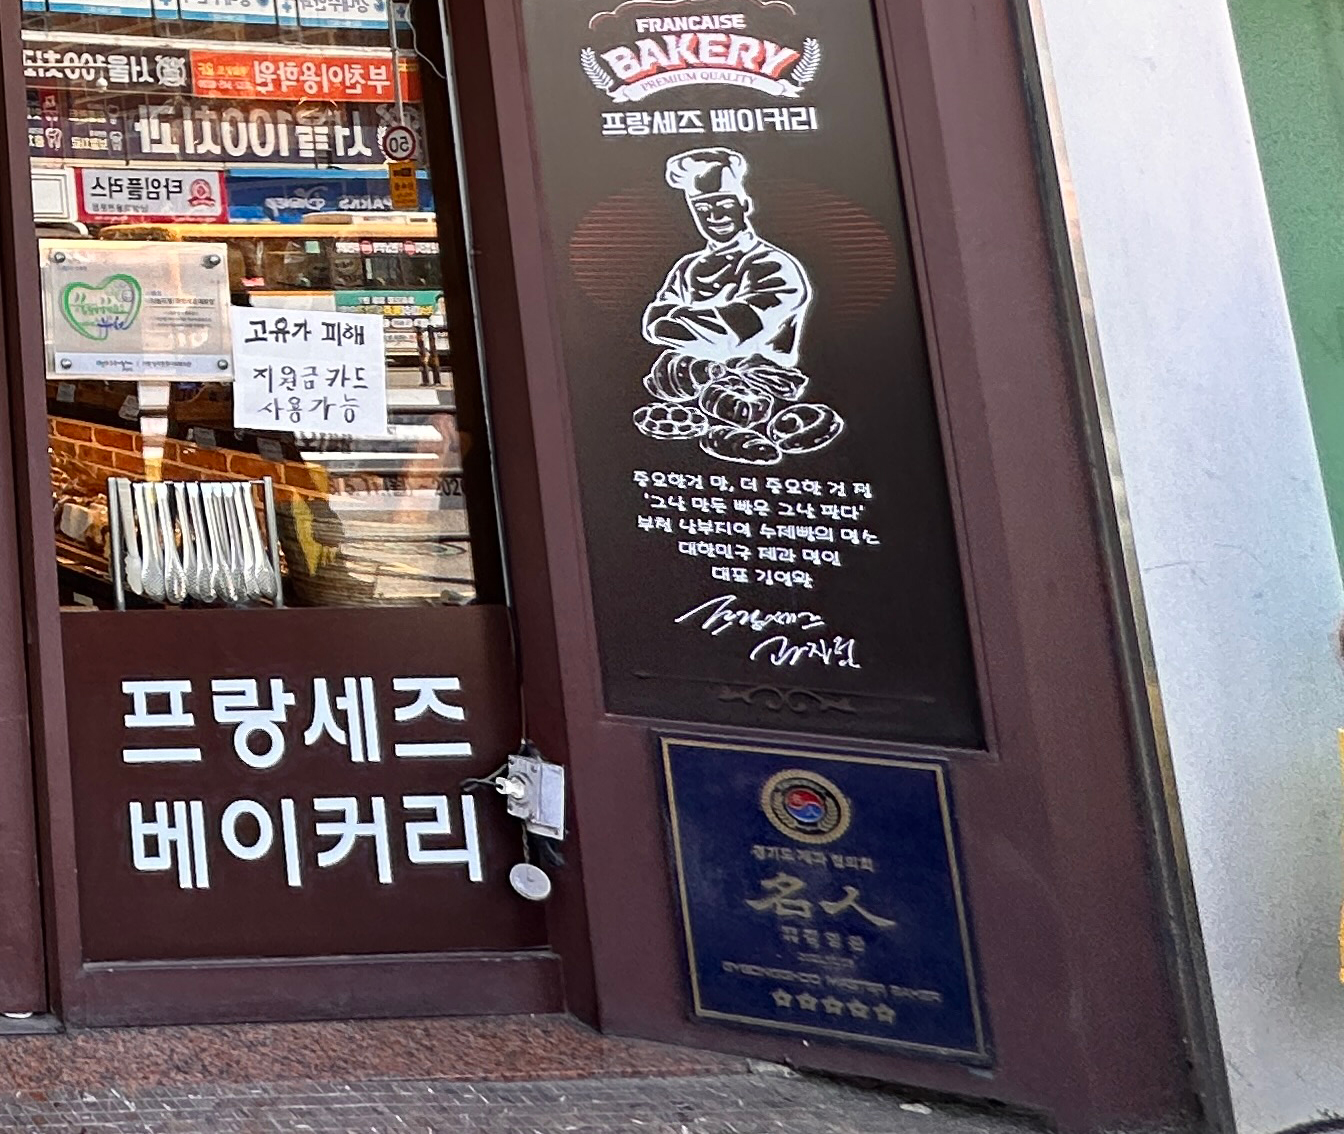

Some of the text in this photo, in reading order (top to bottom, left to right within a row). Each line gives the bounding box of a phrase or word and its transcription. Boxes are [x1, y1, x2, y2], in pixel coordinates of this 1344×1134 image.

[636, 14, 747, 33] FRANCAISE
[600, 32, 801, 83] BAKERY
[640, 72, 758, 92] PREMIUM QUALITY
[601, 107, 818, 136] 프랑세즈 베이커리
[244, 317, 365, 346] 고유가 피해
[740, 477, 758, 493] 더
[678, 540, 753, 562] 대한민국
[121, 677, 472, 768] 프랑세즈
[129, 794, 484, 889] 베이커리
[744, 871, 897, 928] 名人
